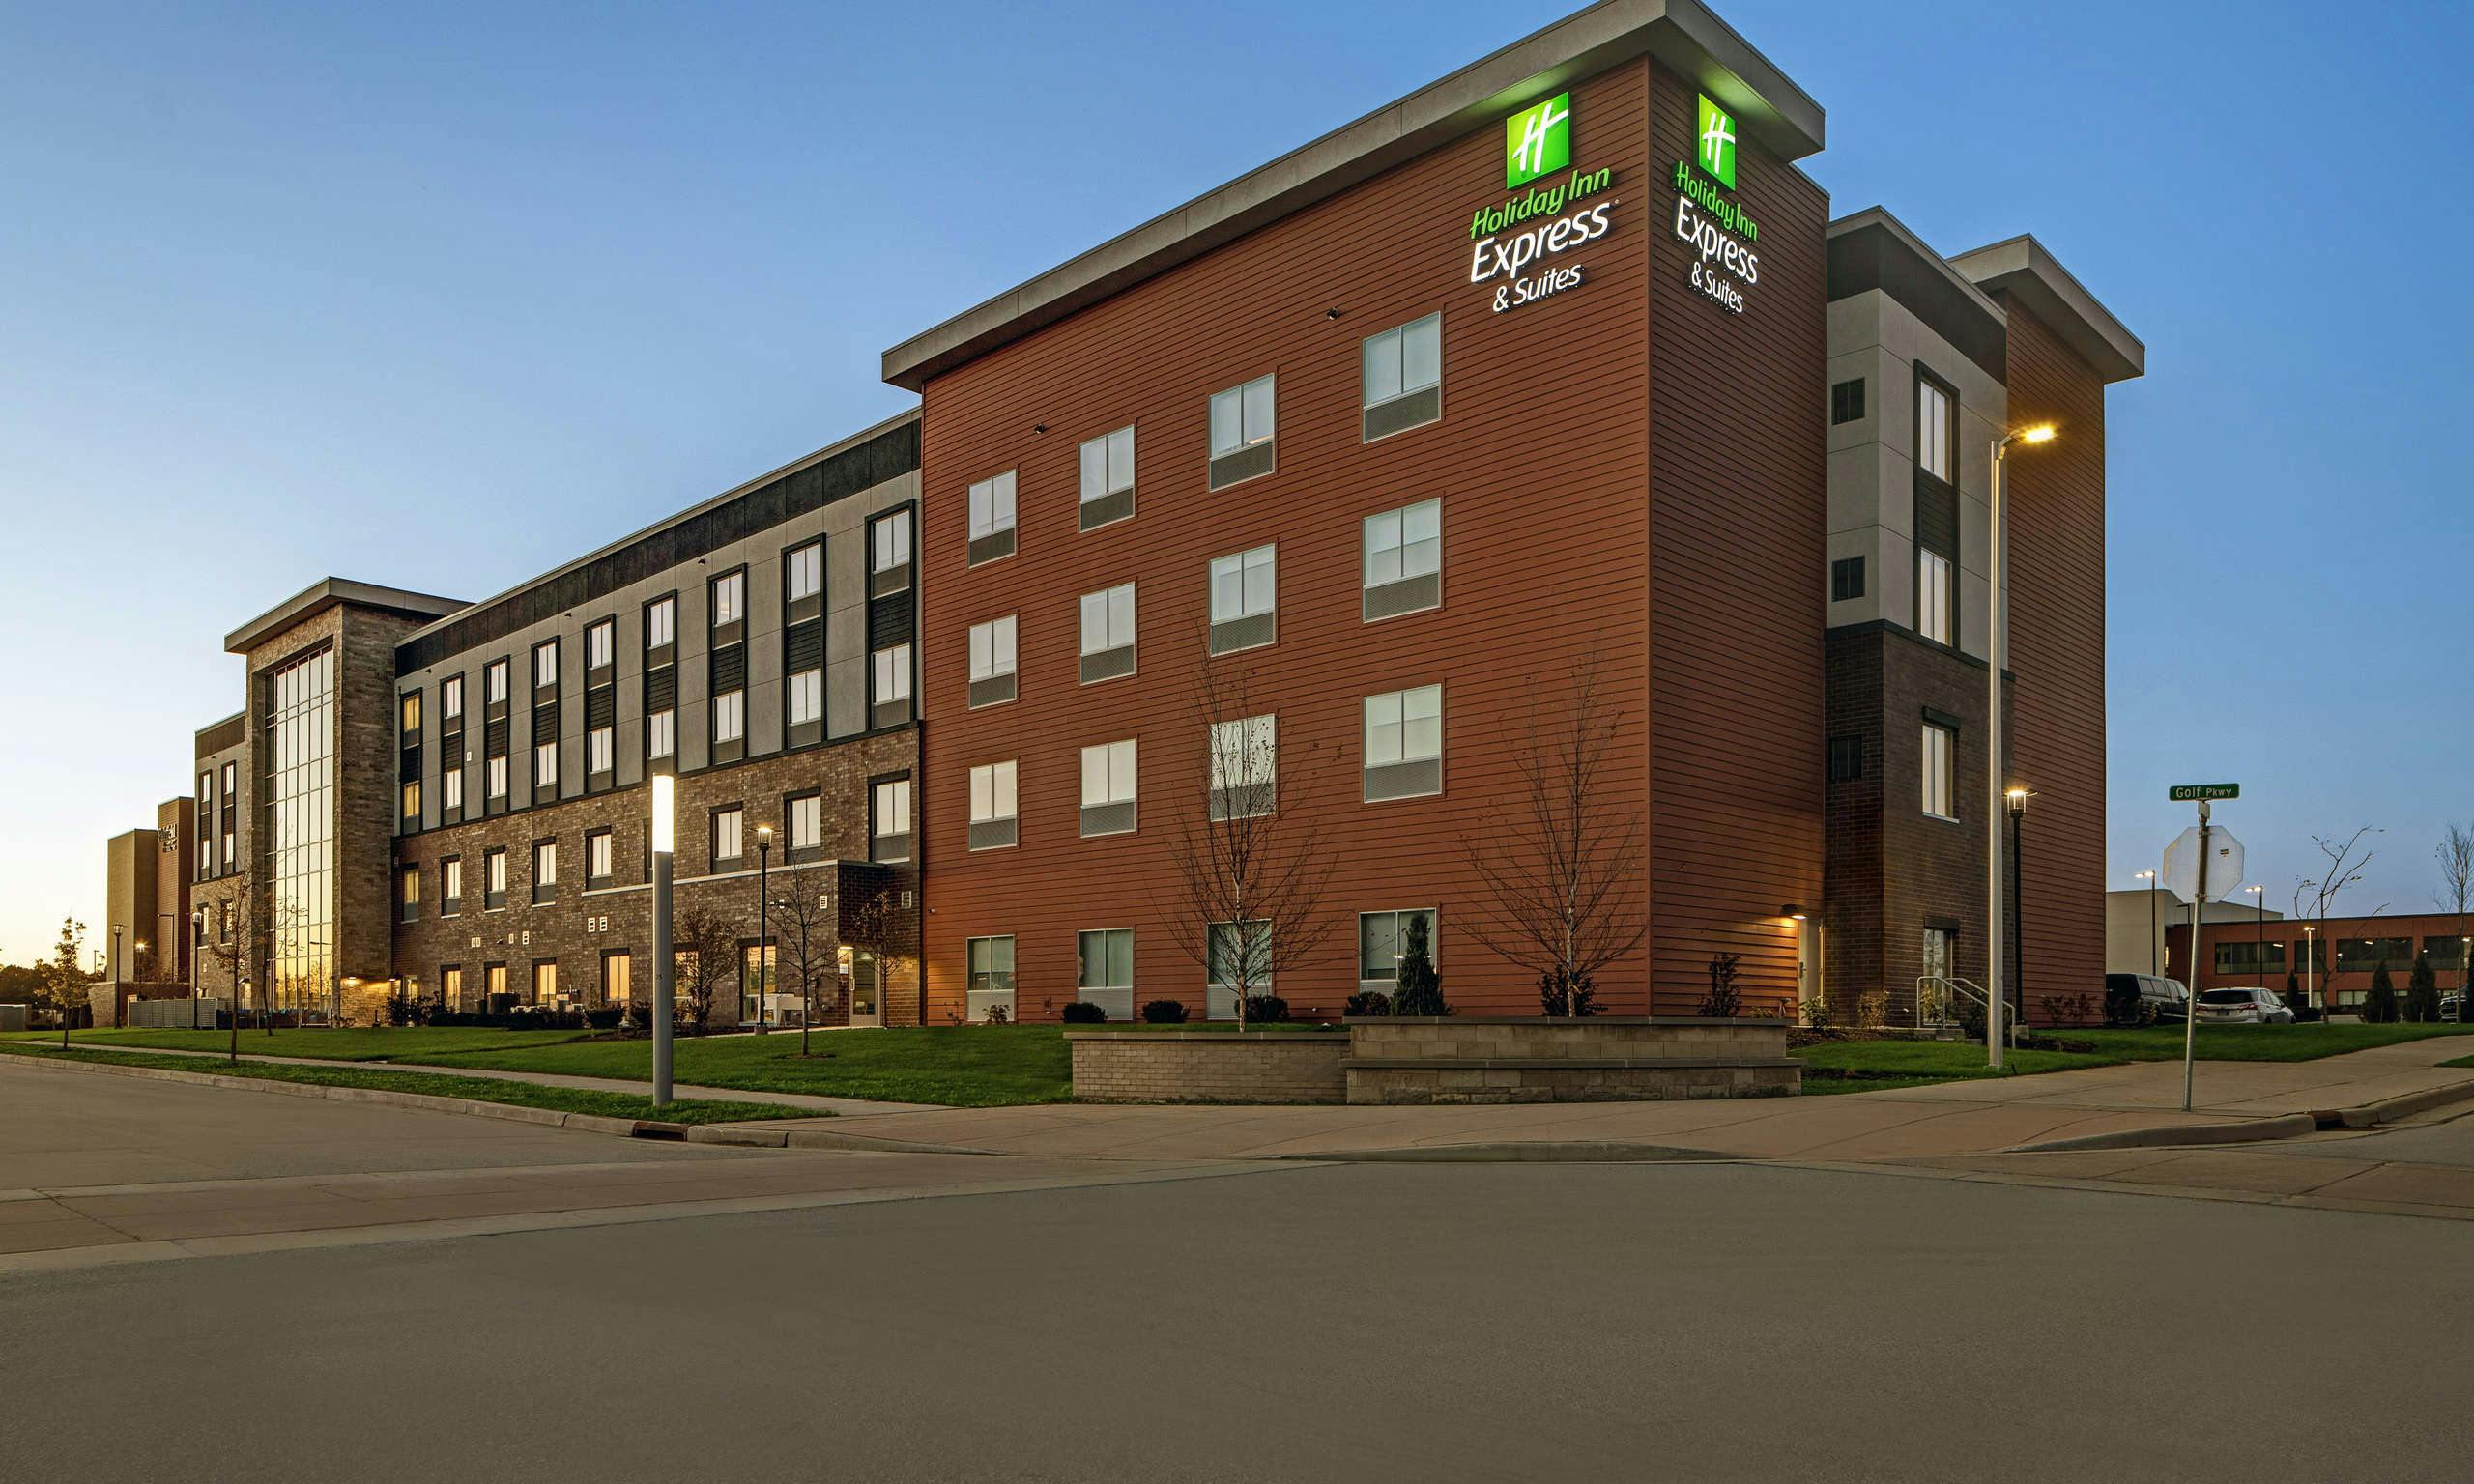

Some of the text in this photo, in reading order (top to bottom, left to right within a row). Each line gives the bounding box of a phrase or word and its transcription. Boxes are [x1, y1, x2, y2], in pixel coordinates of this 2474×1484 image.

[1512, 102, 1569, 173] H
[1702, 112, 1736, 174] H
[1469, 167, 1610, 239] Holiday Inn
[1676, 160, 1757, 241] Holiday Inn
[1470, 202, 1610, 282] Express
[1677, 196, 1758, 283] Express
[1492, 264, 1581, 312] & Suites
[1691, 261, 1743, 313] & Suites
[2175, 786, 2231, 798] Golf Pkwy
